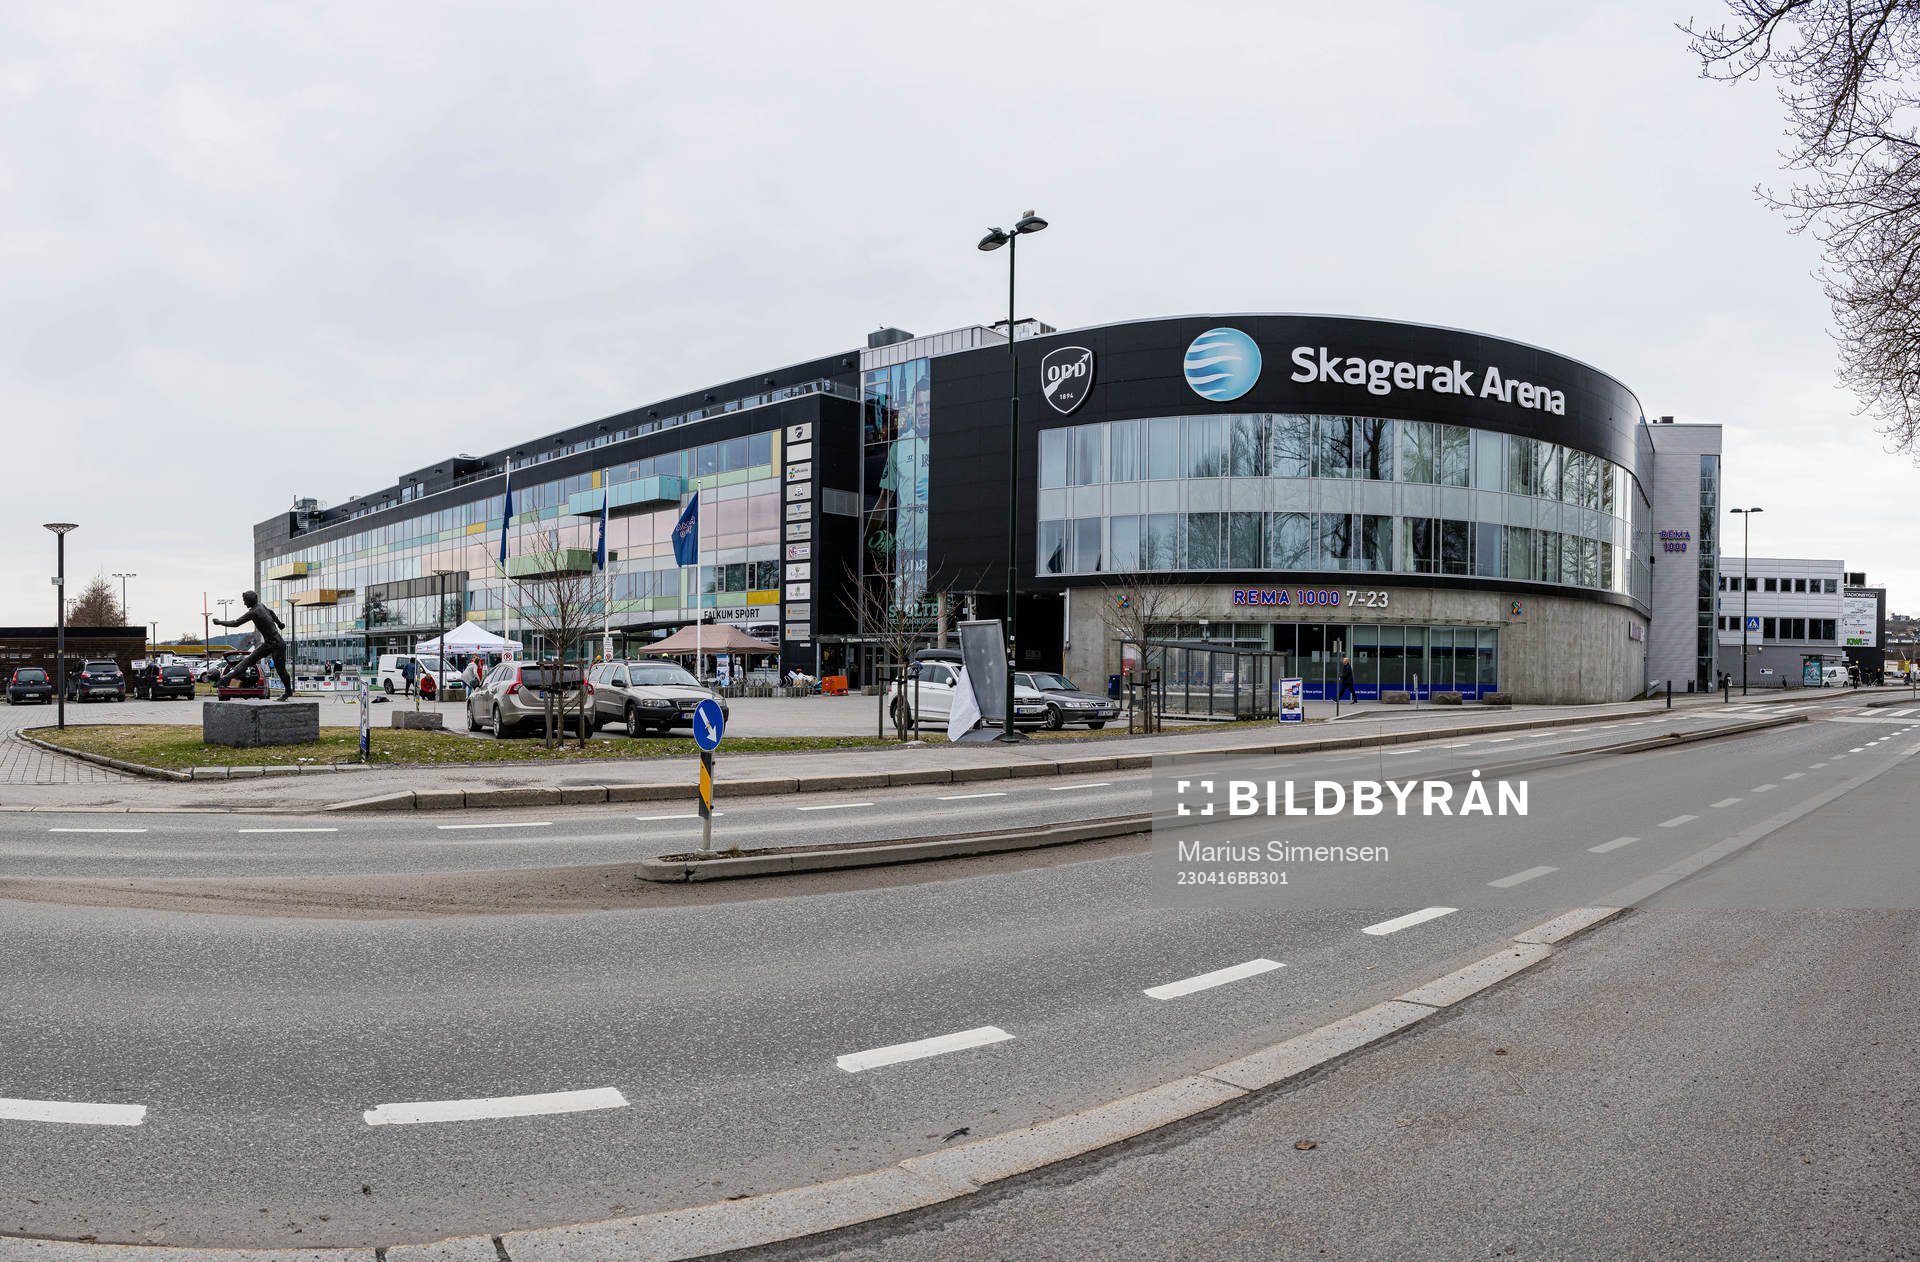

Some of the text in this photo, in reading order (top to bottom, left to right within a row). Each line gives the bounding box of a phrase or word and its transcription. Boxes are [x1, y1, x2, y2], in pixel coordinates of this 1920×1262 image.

[1047, 362, 1087, 381] ODD
[1290, 346, 1565, 416] Skagerak Arena
[1060, 392, 1074, 400] 1894
[1660, 530, 1690, 541] REMA
[1664, 542, 1687, 552] 1000
[1232, 589, 1390, 608] REMA 1000 7-23
[704, 608, 760, 620] FALKUM SPORT
